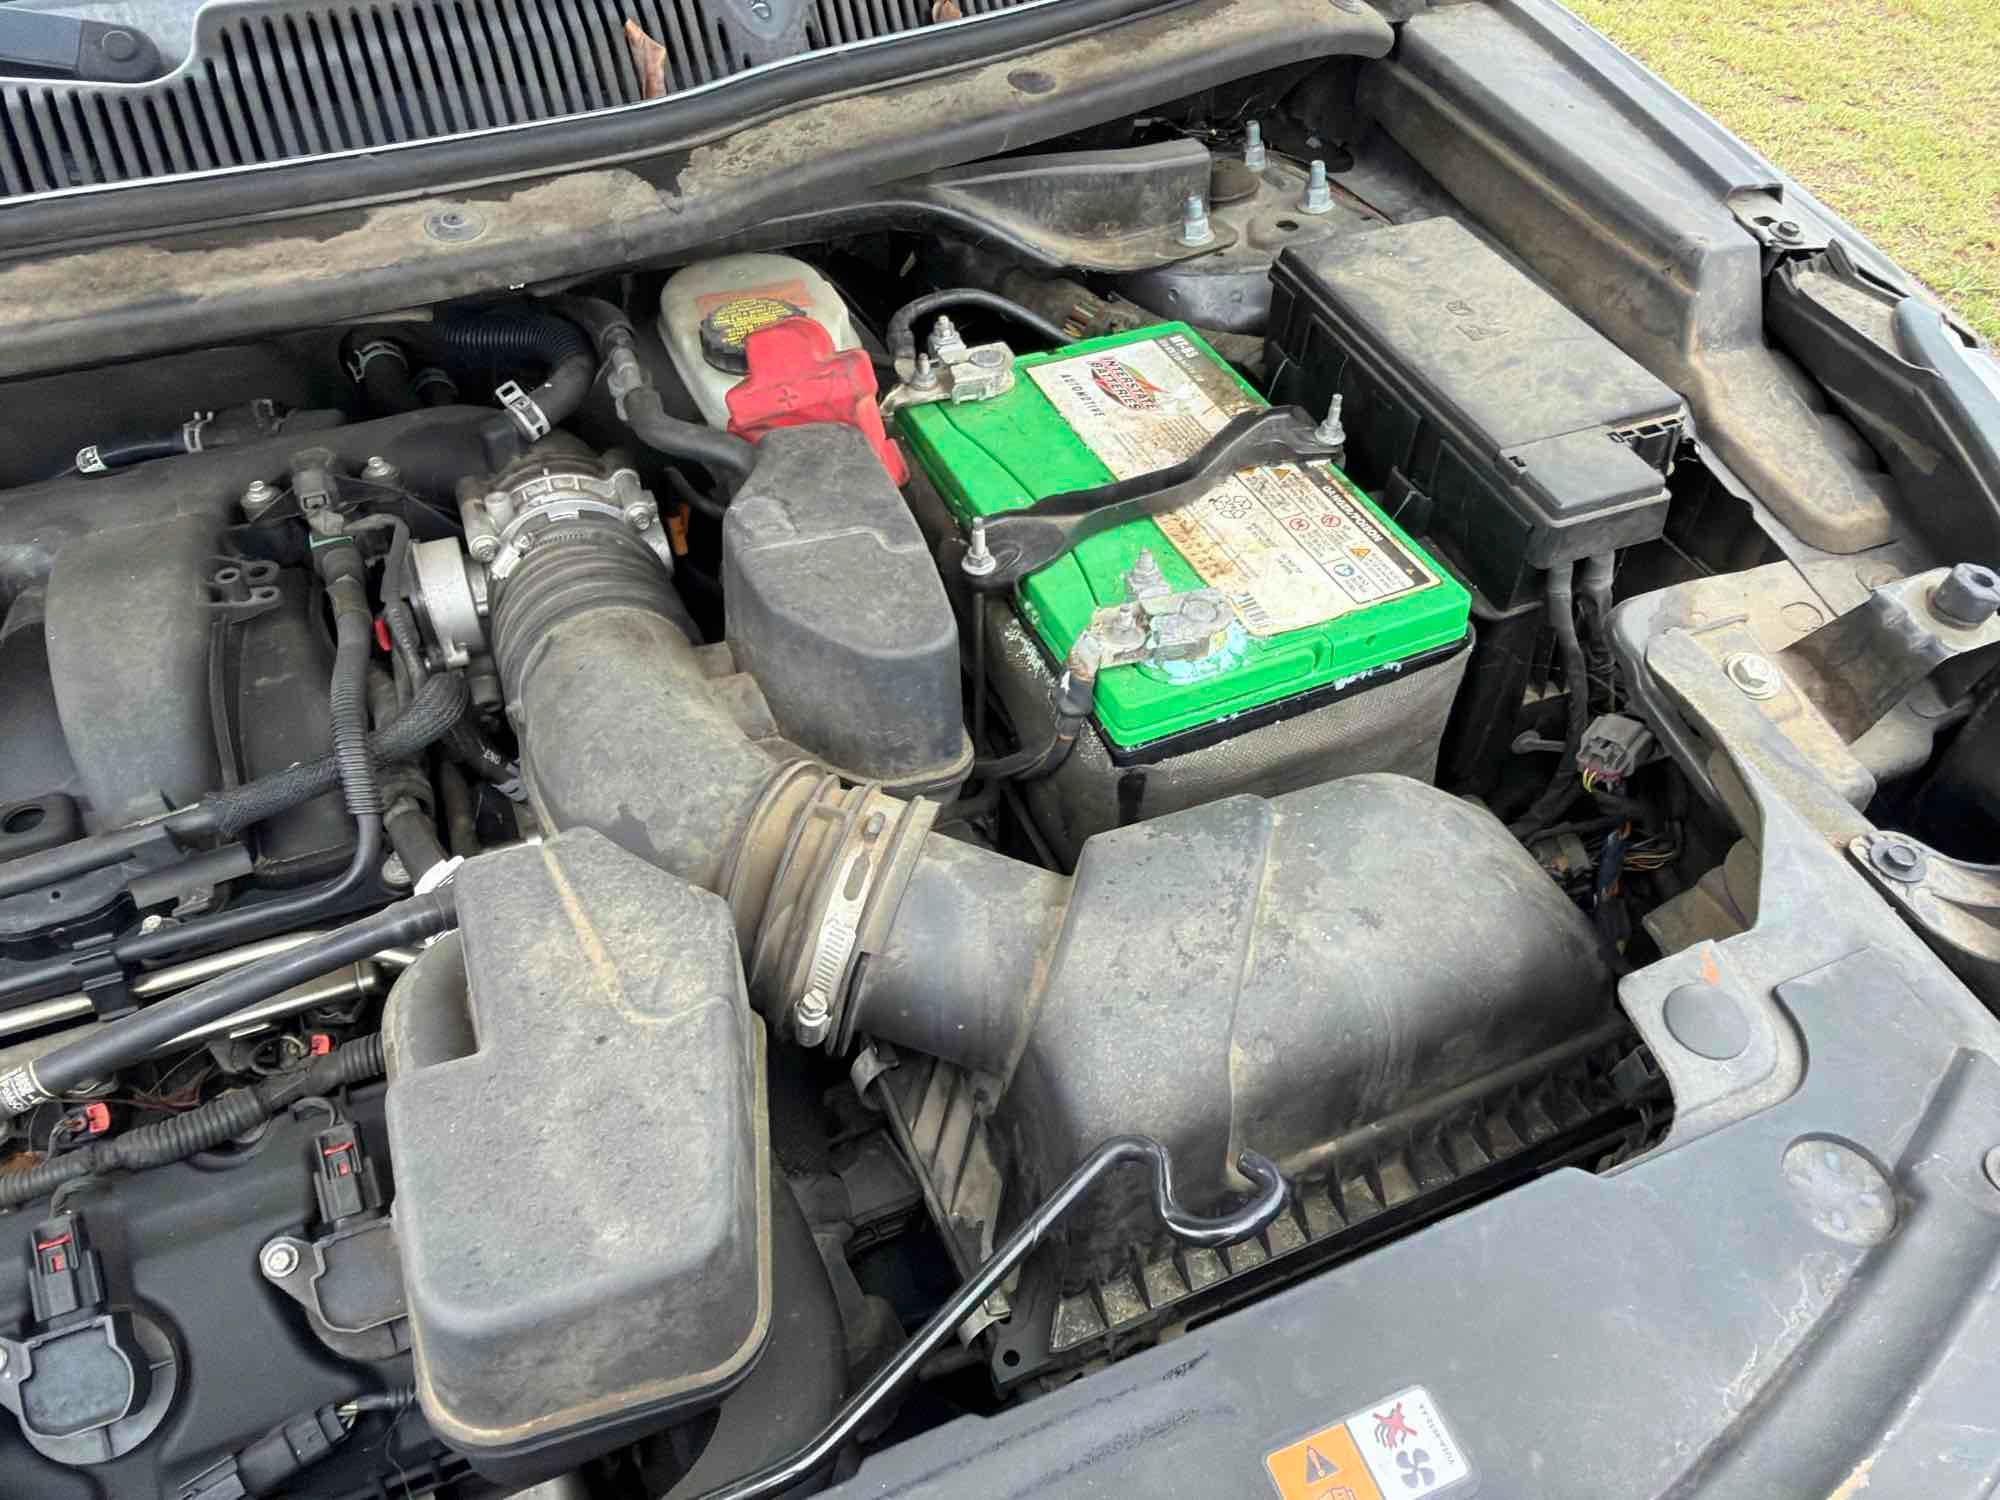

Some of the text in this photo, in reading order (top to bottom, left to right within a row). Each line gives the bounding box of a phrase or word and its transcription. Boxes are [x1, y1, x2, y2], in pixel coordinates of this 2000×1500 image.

[1060, 374, 1105, 416] AUTOMOTIVE
[1086, 361, 1141, 409] BATTERIES
[1100, 356, 1160, 410] INTERSTATE
[1322, 485, 1384, 542] DANGER/POISON
